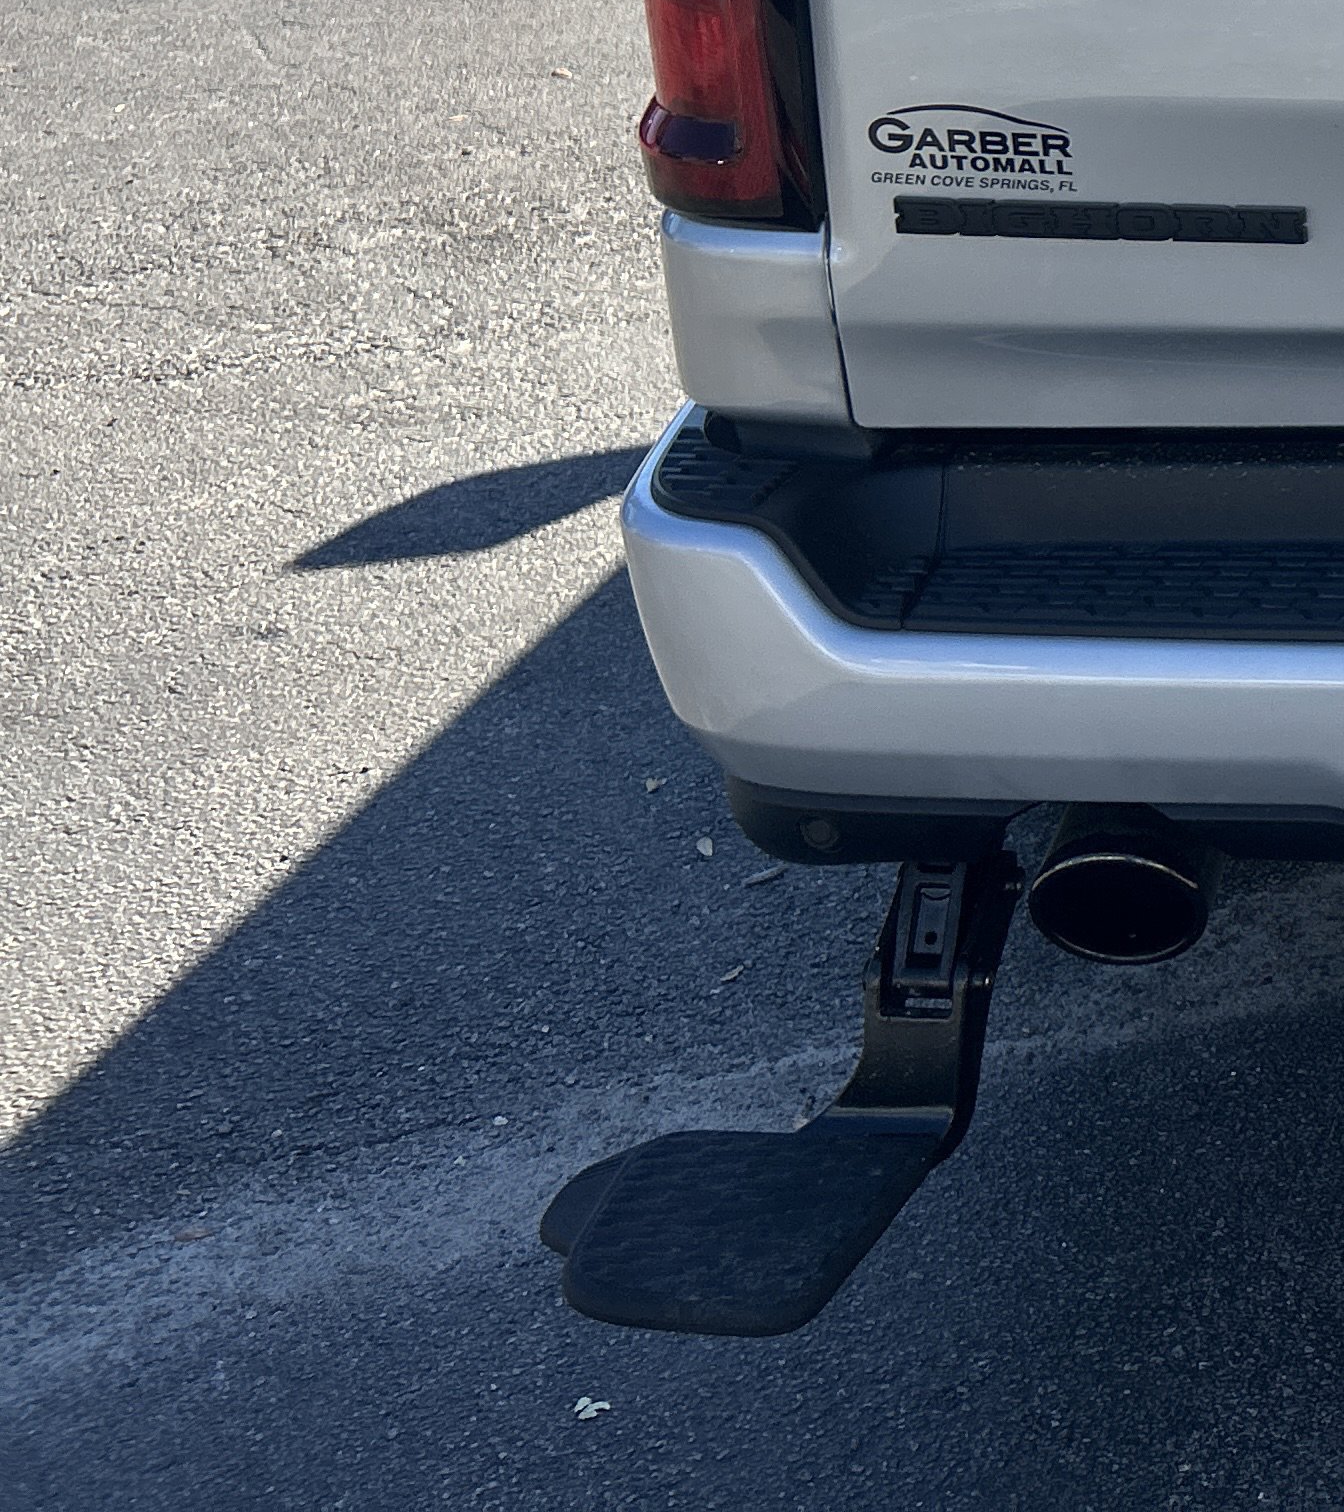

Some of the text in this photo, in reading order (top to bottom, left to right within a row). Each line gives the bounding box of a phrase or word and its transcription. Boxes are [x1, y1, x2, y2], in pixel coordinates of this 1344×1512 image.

[868, 117, 1073, 158] GARBER
[909, 153, 1074, 176] AUTOMALL
[871, 171, 1078, 193] GREEN COVE SPRINGS, FL
